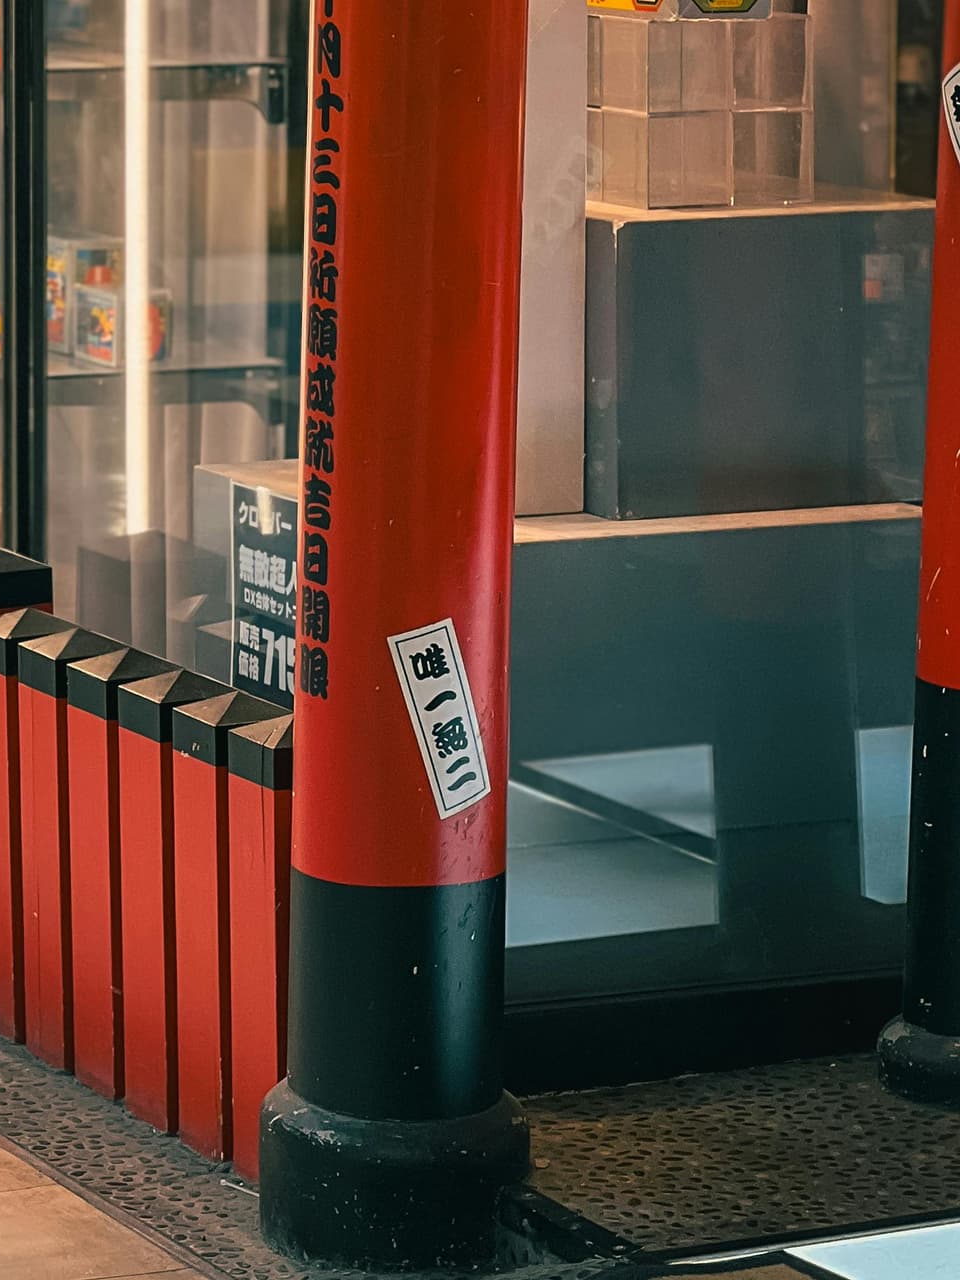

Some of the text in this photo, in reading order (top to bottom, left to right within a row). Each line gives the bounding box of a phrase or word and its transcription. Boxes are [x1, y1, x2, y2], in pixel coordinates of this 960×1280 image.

[239, 501, 292, 535] クロバー
[244, 587, 297, 620] DX合体セット
[239, 620, 260, 651] 販売
[238, 650, 259, 681] 価格
